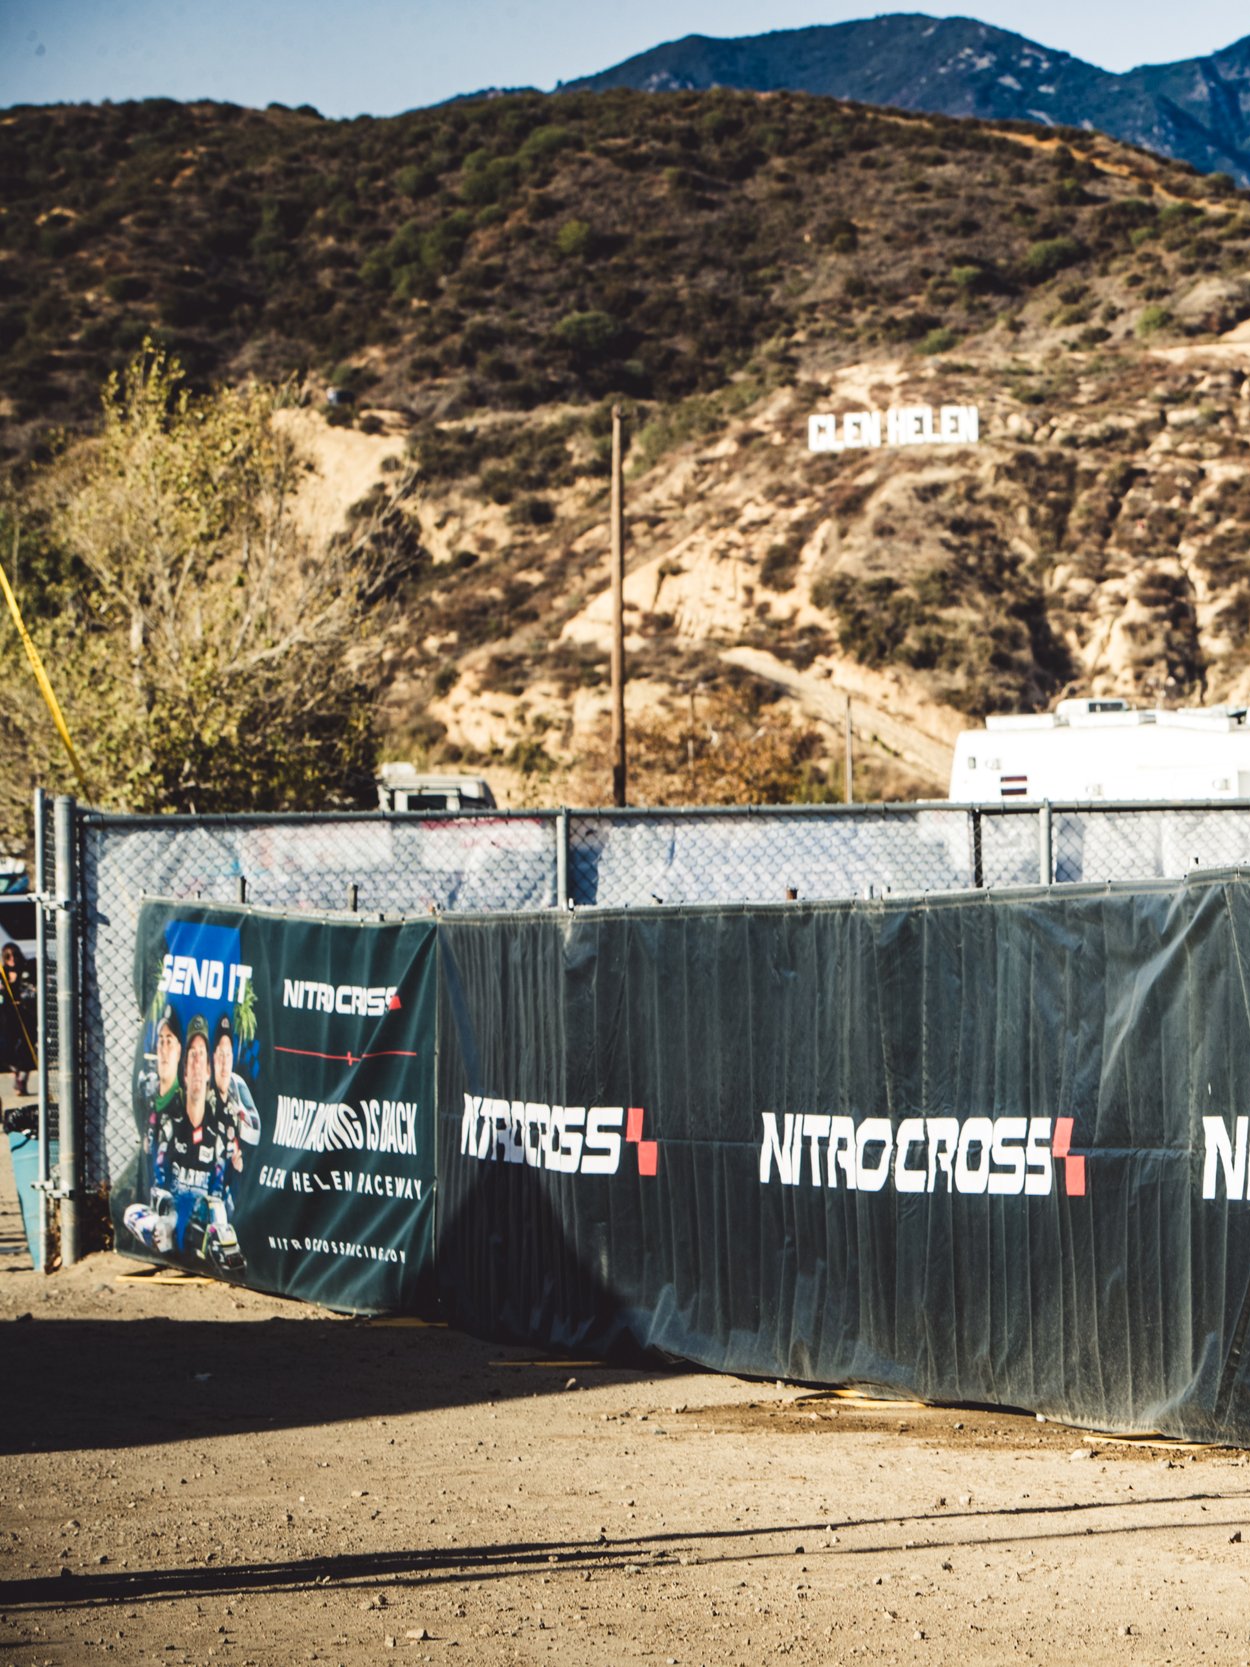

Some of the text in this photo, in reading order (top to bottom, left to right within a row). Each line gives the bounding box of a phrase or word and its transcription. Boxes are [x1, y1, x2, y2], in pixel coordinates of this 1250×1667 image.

[808, 405, 979, 451] GLEN HELEN
[158, 953, 253, 1004] SEND IT
[360, 1099, 380, 1151] IS
[379, 1100, 417, 1155] BACK
[760, 1111, 1053, 1195] NITROCROSS
[259, 1165, 422, 1200] GLEN HELEN RACEWAY
